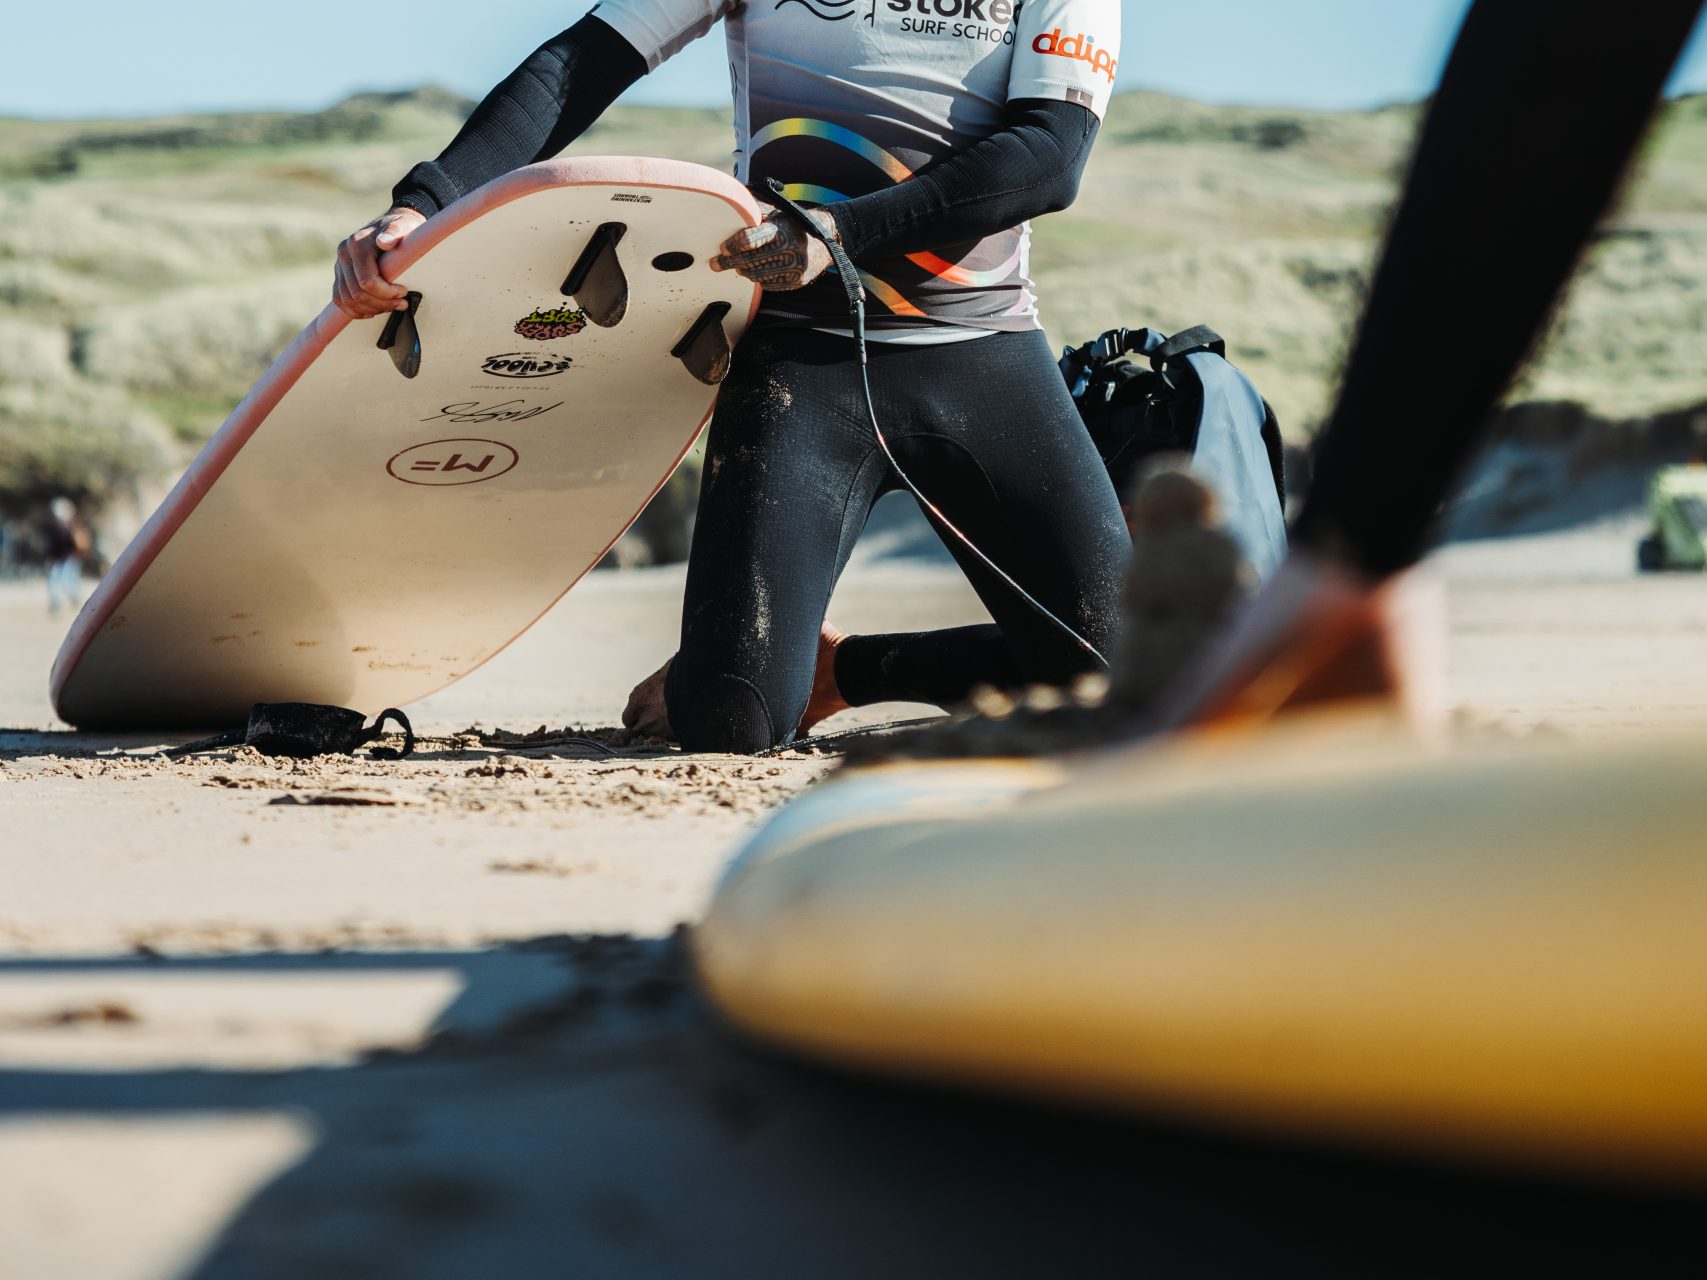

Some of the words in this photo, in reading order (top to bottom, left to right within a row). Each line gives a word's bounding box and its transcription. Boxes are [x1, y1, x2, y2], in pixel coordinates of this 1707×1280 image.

[900, 17, 947, 36] SURF
[952, 23, 1017, 47] SCHOO
[1077, 91, 1084, 103] L
